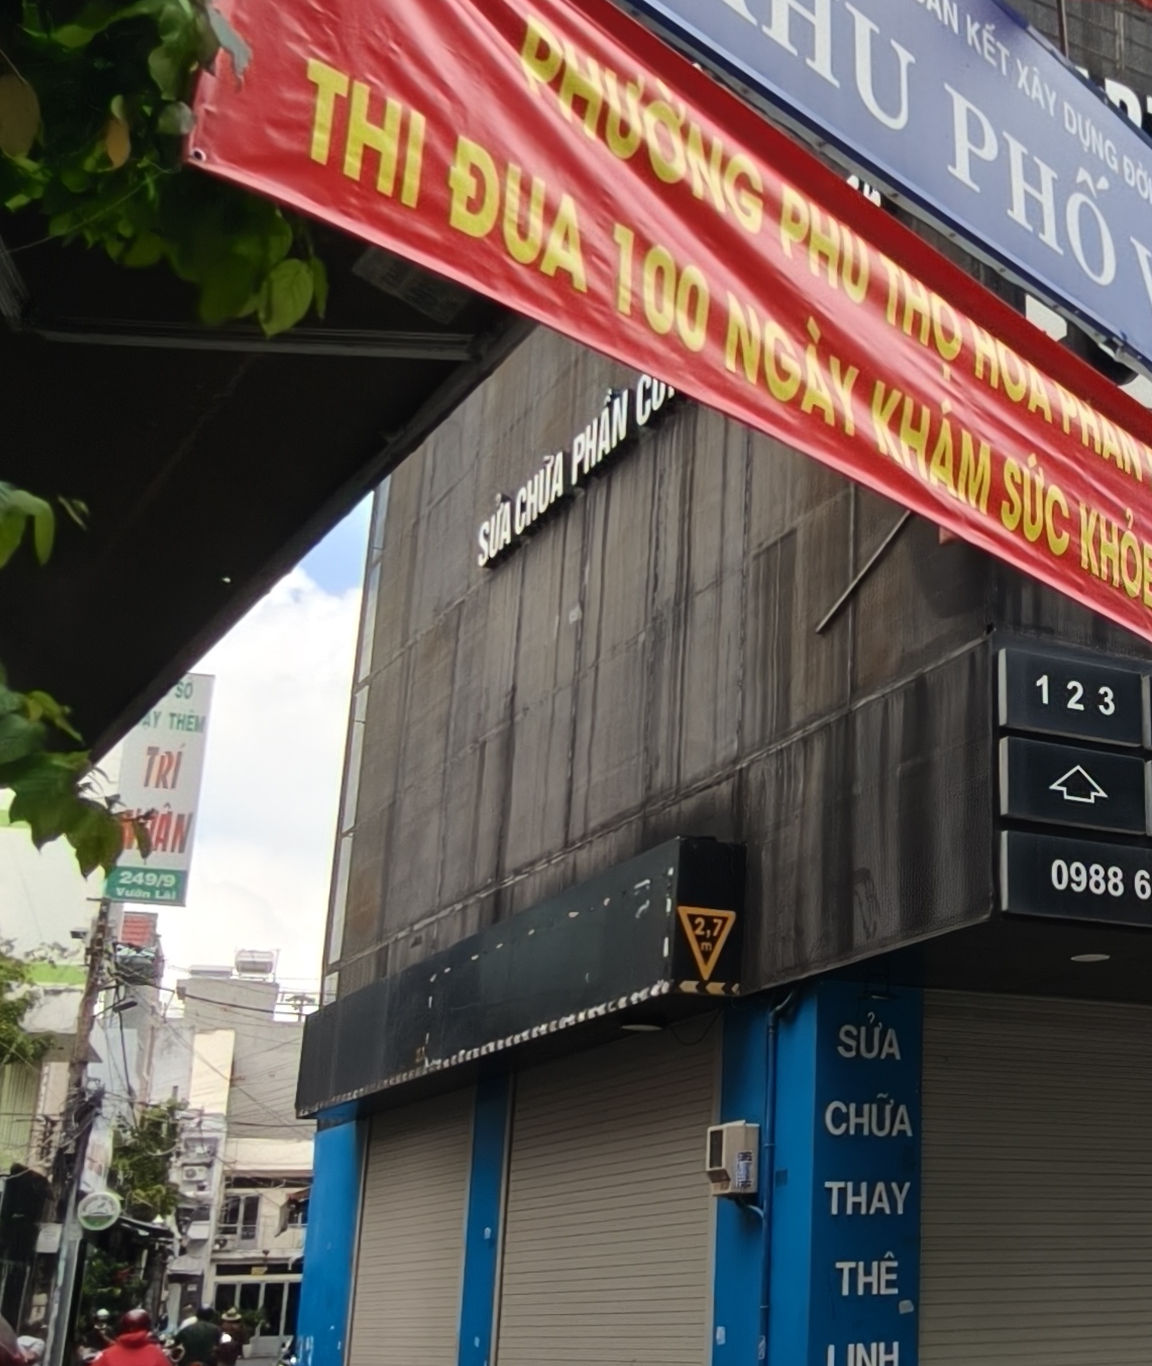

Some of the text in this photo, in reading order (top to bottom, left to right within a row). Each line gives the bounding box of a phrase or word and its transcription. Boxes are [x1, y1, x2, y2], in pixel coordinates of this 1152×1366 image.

[966, 13, 1010, 76] KẾT
[1017, 58, 1058, 117] XÂY
[1063, 101, 1118, 174] DỰNG
[519, 12, 766, 236] PHƯỜNG
[944, 82, 1117, 287] PHỐ
[306, 56, 426, 209] THI
[447, 134, 589, 294] ĐUA
[613, 222, 712, 353] 100
[723, 290, 859, 438] NGÀY
[871, 380, 992, 516] KHÁM
[1000, 453, 1071, 556] SỨC
[477, 492, 511, 567] SỬA
[514, 450, 564, 535] CHỮA
[571, 387, 629, 486] PHẦN
[143, 742, 186, 790] TRÍ
[118, 869, 176, 889] 249/9
[1050, 858, 1124, 897] 0988
[694, 917, 723, 939] 2,7
[701, 941, 712, 952] m
[837, 1012, 901, 1061] SỬA
[824, 1092, 913, 1137] CHỮA
[824, 1180, 911, 1215] THAY
